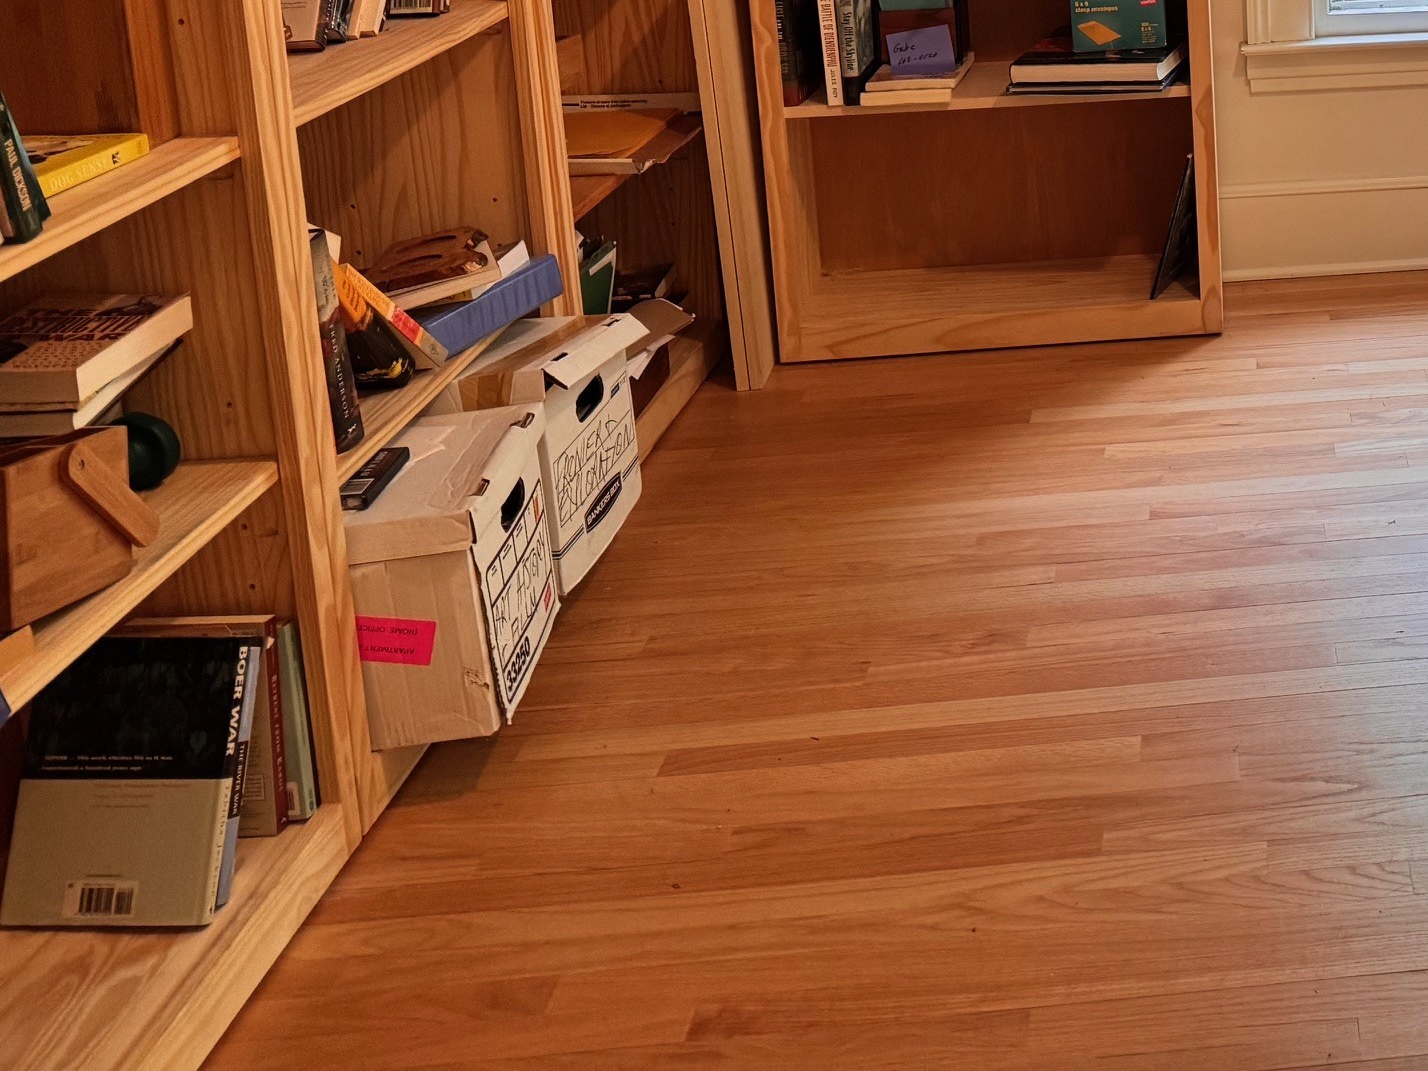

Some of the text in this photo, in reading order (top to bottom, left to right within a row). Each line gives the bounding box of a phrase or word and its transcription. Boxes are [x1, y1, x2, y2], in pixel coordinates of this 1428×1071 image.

[842, 11, 851, 28] Stay
[4, 139, 30, 212] PAUL DICKSON
[334, 357, 349, 419] ANDERSON
[586, 481, 621, 526] BANKERS BOX
[366, 645, 416, 655] APARTMENT
[505, 635, 531, 693] 33250
[226, 645, 249, 757] BOER WAR
